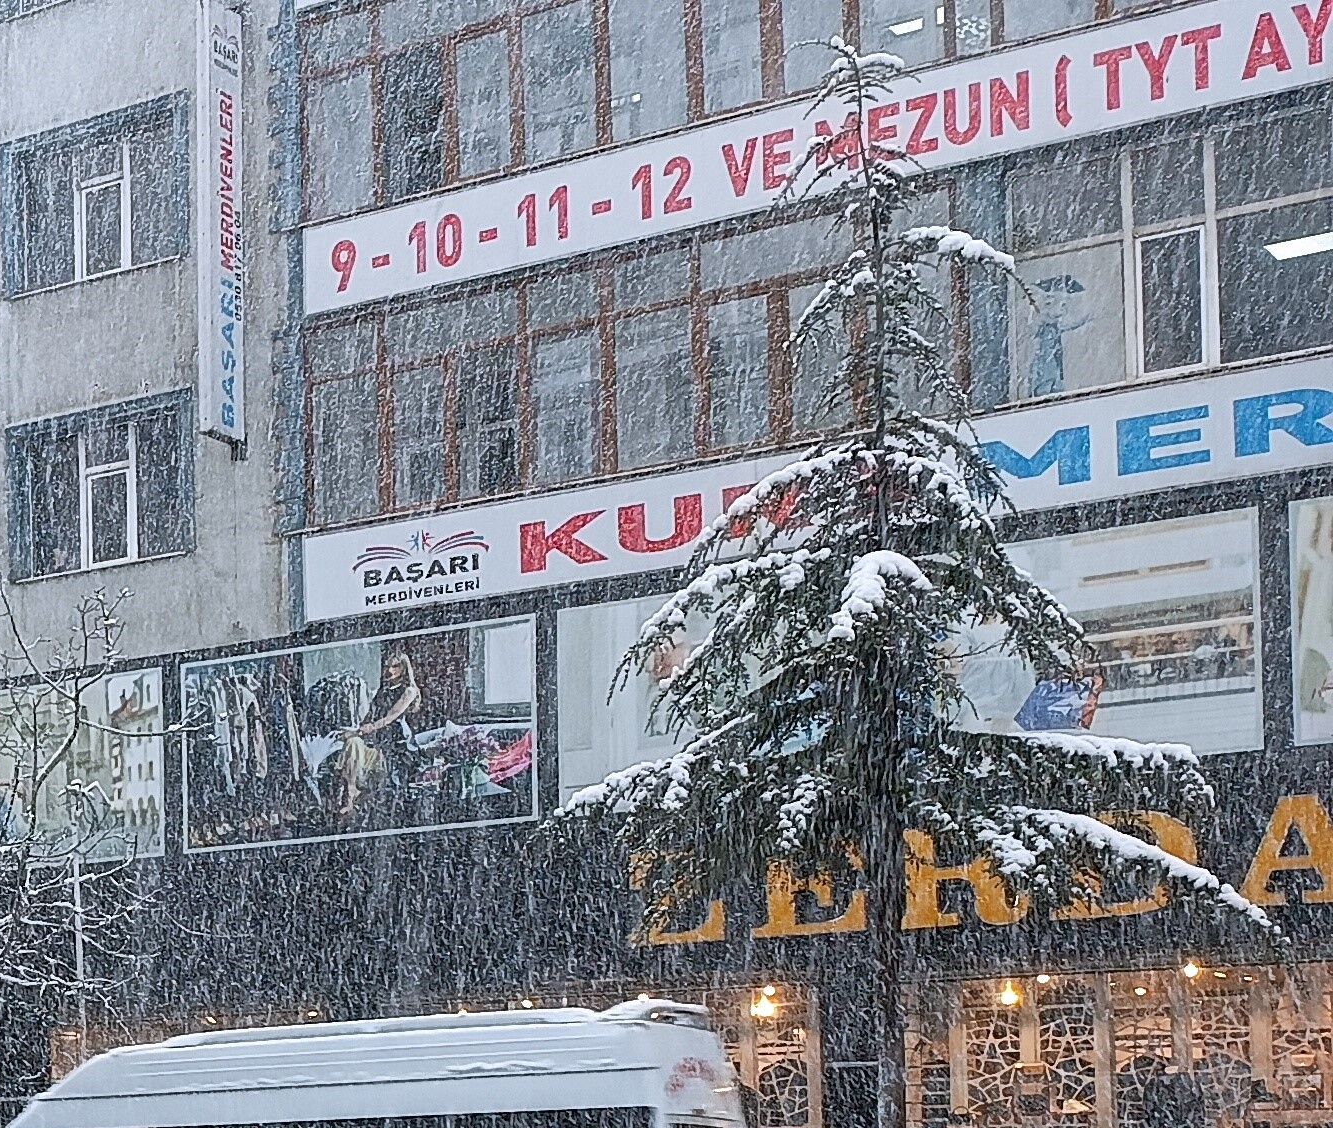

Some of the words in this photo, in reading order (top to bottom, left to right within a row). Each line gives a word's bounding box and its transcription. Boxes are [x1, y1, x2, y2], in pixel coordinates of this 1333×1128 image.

[722, 128, 794, 198] VE
[814, 69, 1030, 171] MEZUN
[1093, 24, 1222, 111] TYT
[216, 87, 234, 272] MERDİVENLERİ
[220, 276, 236, 429] BAŞARI
[980, 388, 1333, 486] MER
[363, 552, 480, 588] BAŞARI
[365, 576, 480, 607] MERDİVENLERİ
